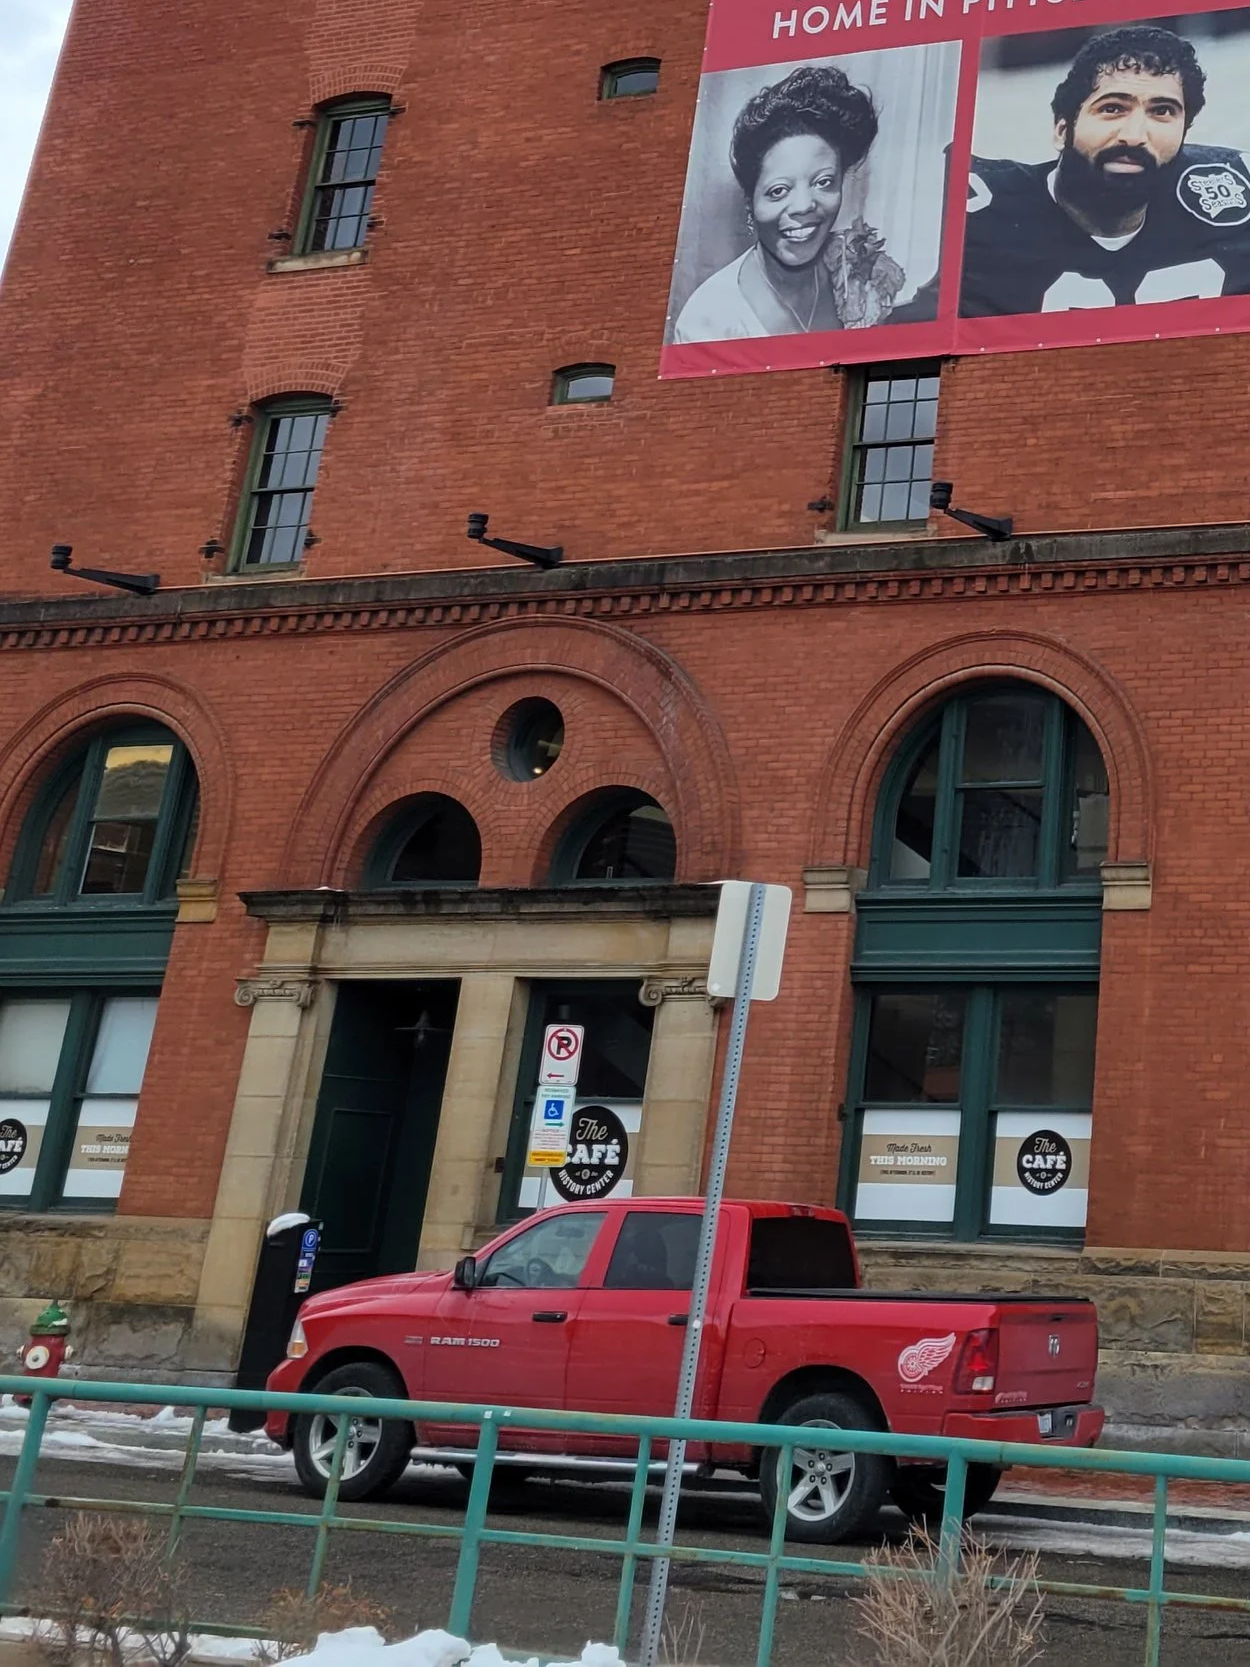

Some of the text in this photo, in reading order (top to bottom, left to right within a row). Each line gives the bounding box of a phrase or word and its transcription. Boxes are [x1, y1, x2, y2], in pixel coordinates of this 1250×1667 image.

[1205, 184, 1231, 200] 50
[576, 1117, 609, 1140] The
[0, 1137, 23, 1152] AFÉ
[1033, 1137, 1057, 1153] The
[870, 1155, 947, 1166] THIS MORNING
[1022, 1151, 1066, 1169] CAFÉ
[558, 1169, 614, 1195] HISTORY CENTER
[430, 1336, 500, 1347] RAM 1500
